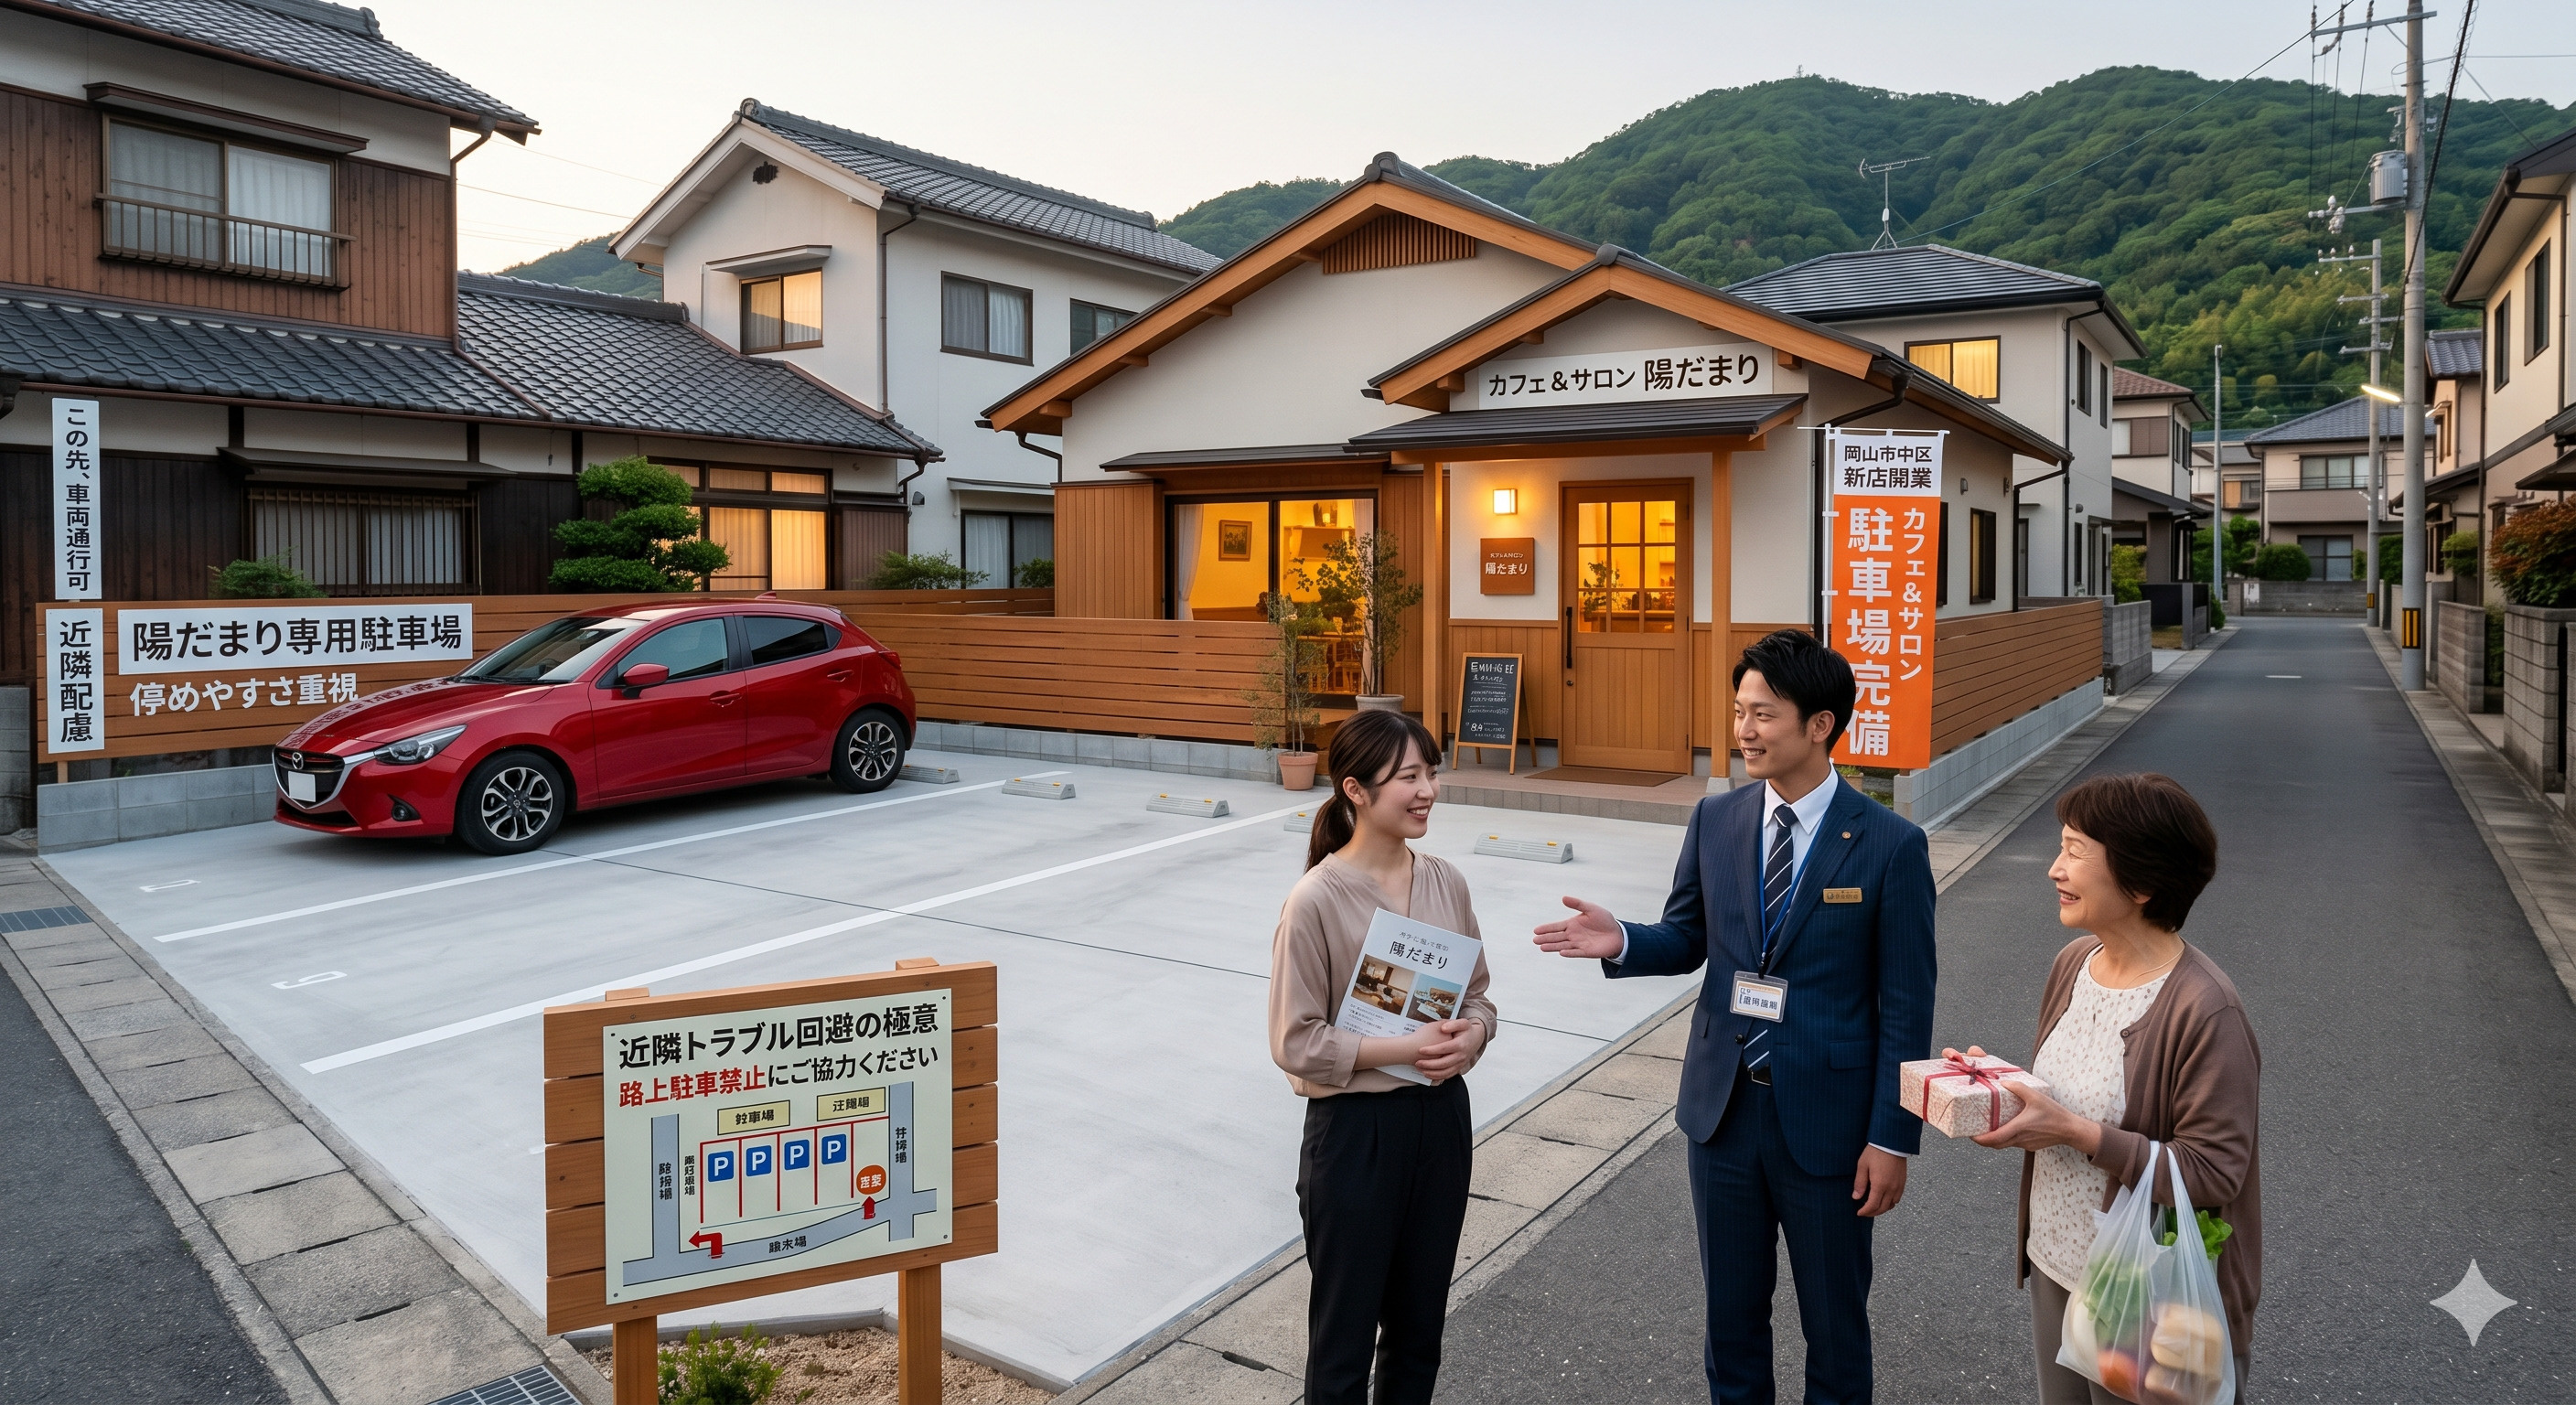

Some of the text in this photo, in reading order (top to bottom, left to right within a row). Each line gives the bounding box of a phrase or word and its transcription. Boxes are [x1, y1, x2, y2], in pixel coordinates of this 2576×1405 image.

[1645, 354, 1761, 391] 陽だまり
[1843, 466, 1932, 489] 新店開業
[1844, 445, 1933, 463] 岡山市中区
[65, 408, 91, 592] この先、車両通行可
[133, 615, 463, 662] 陽だまり専用駐車場
[1846, 507, 1894, 756] 駐車場完備
[59, 619, 93, 743] 近隣配慮
[129, 672, 359, 717] 停めやすさ重視
[618, 1003, 939, 1070] 近隣トラブル回避の極意
[618, 1046, 939, 1109] 路上駐車禁止にご協力ください
[714, 1157, 729, 1176] P
[753, 1151, 767, 1171] P
[790, 1145, 804, 1165] P
[828, 1140, 841, 1160] P
